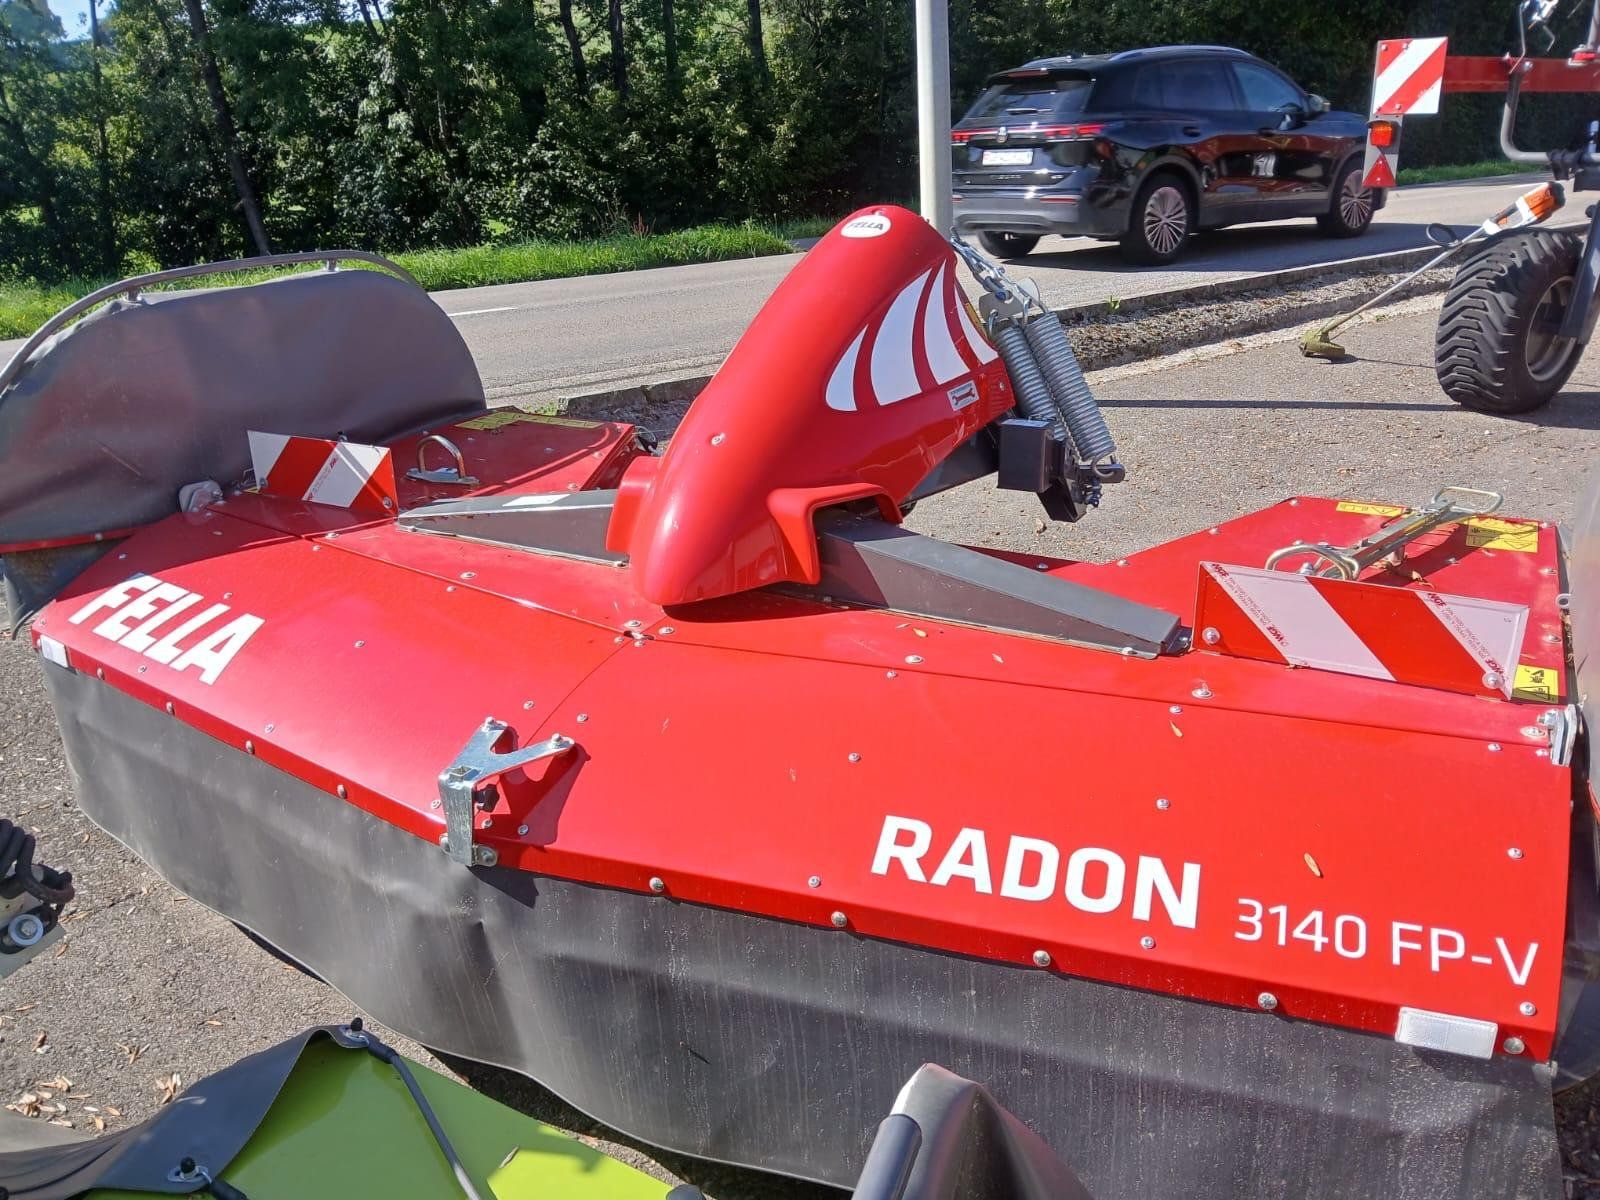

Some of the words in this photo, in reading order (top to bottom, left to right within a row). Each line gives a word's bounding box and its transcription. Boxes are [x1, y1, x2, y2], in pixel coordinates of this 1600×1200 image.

[67, 574, 266, 686] FELLA
[870, 814, 1201, 929] RADON
[1234, 898, 1368, 959] 3140
[1392, 920, 1539, 986] FP-V
